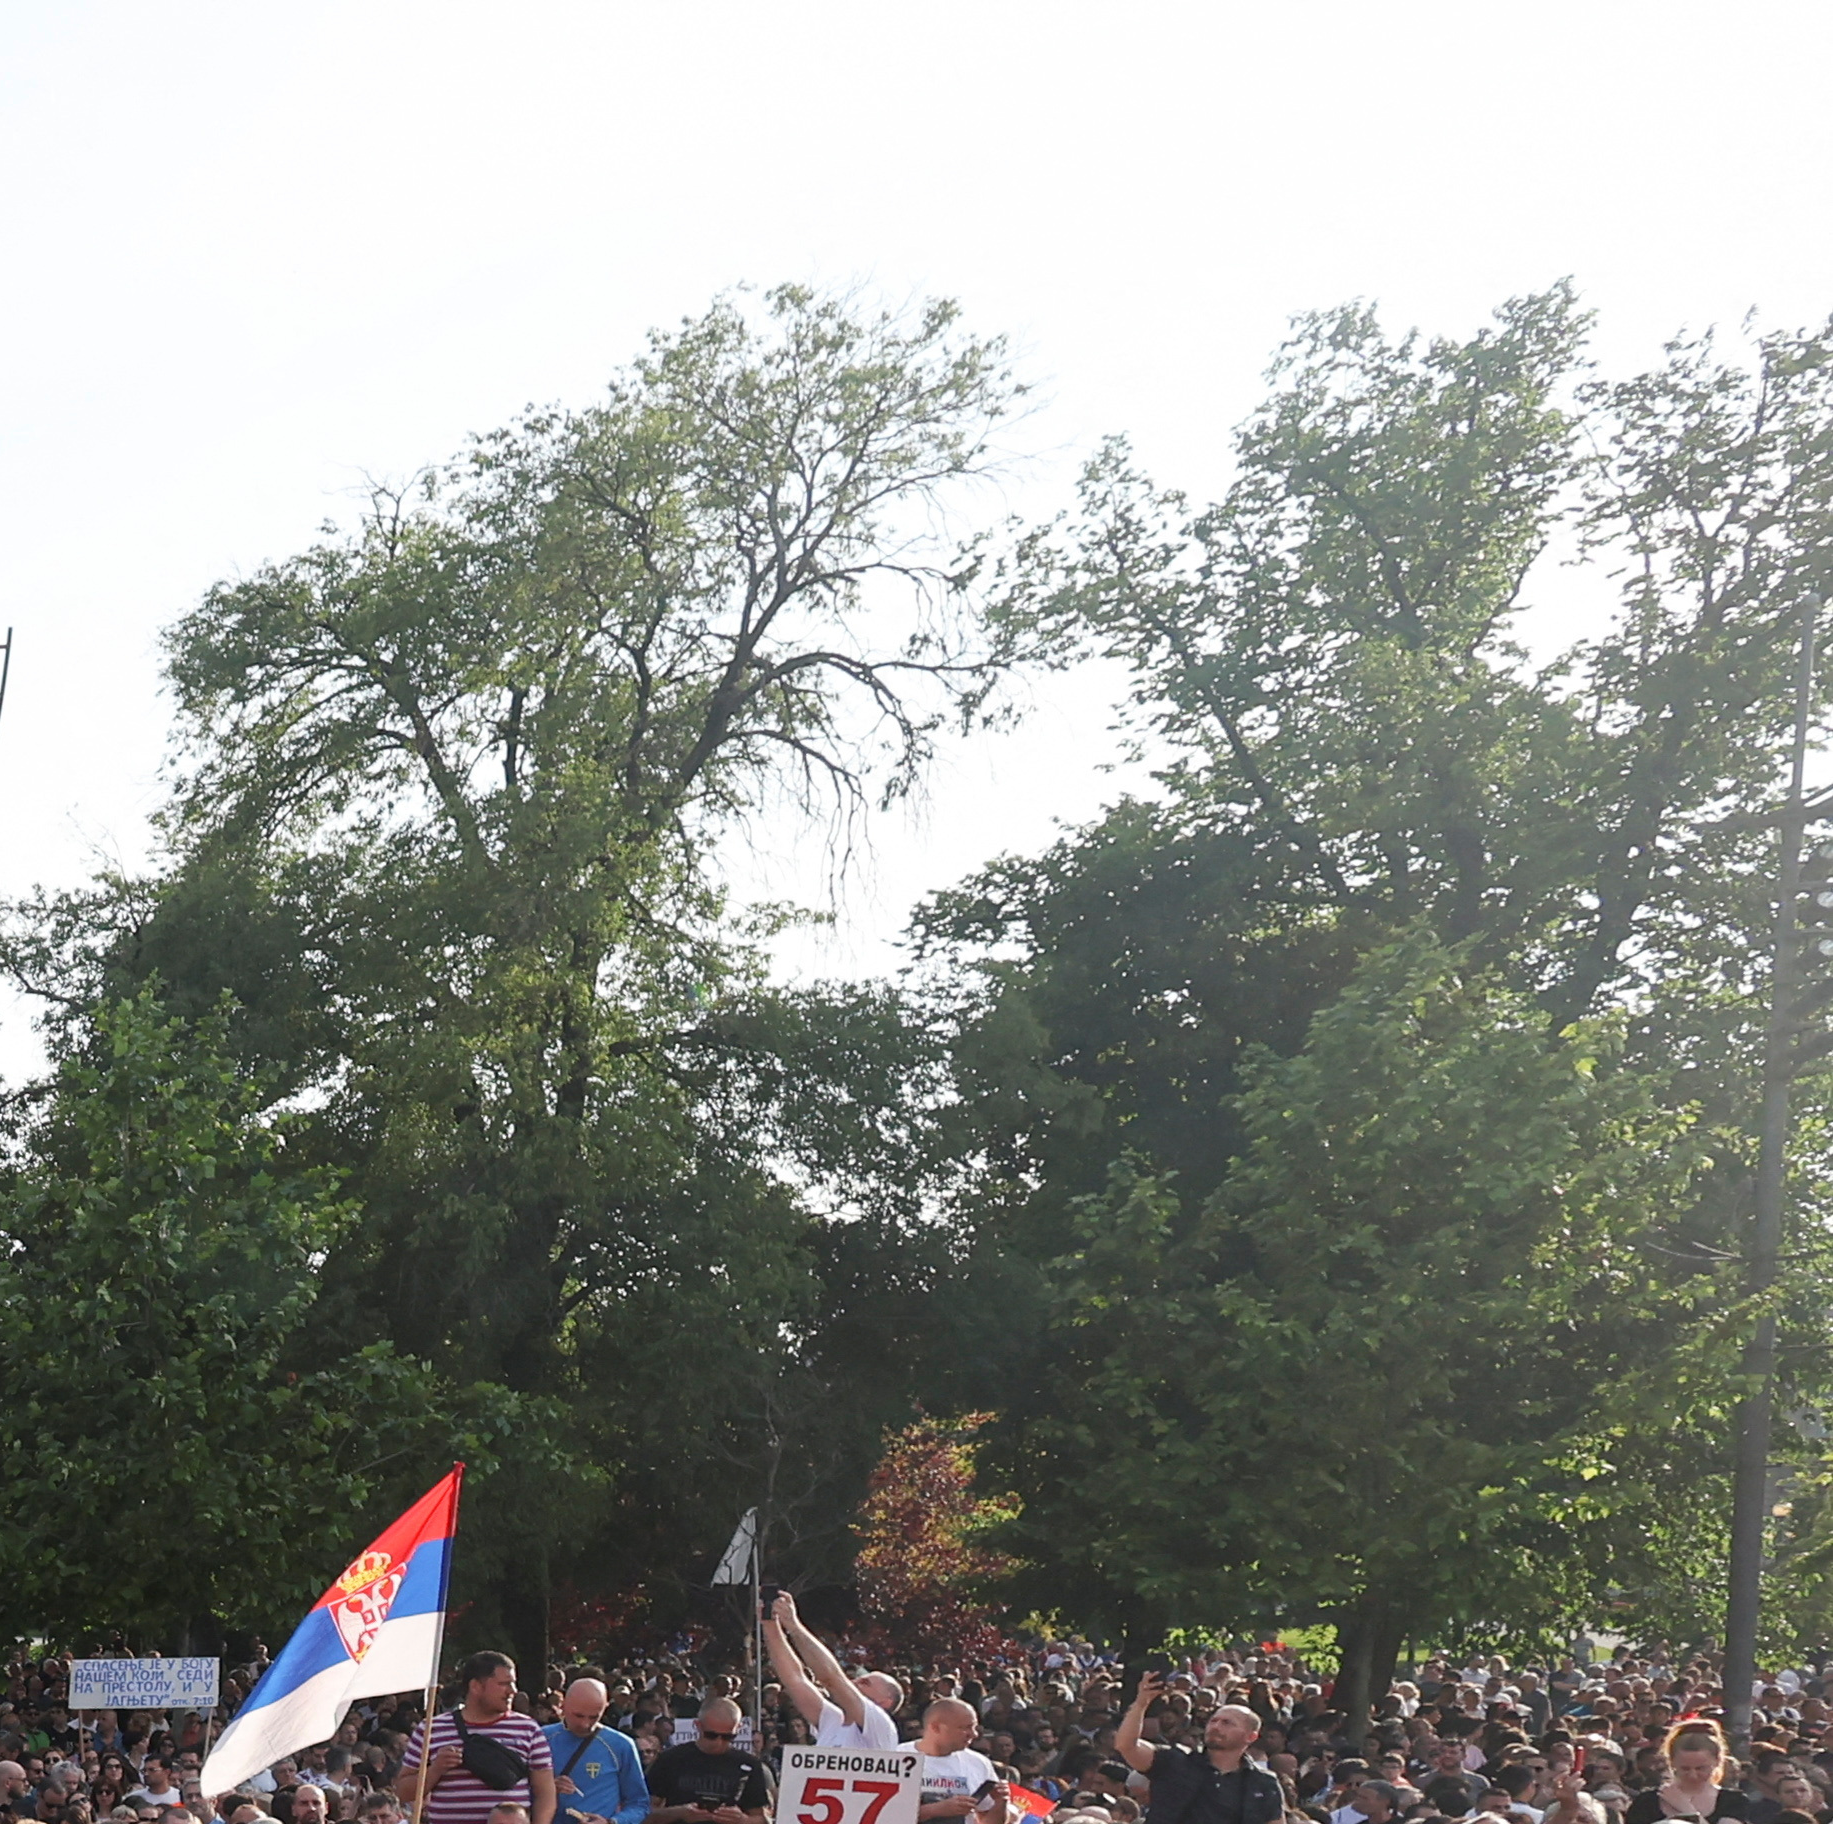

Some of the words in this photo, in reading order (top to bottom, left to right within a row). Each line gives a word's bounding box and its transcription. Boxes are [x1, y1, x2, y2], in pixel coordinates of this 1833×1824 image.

[149, 1660, 162, 1670] ЈЕ
[167, 1660, 176, 1669] У
[181, 1658, 214, 1669] БОГУ
[74, 1670, 127, 1683] НАШЕМ
[132, 1670, 164, 1681] КОЈИ
[176, 1669, 214, 1682] СЕДИ
[74, 1683, 93, 1693] НА
[182, 1682, 192, 1692] И
[204, 1681, 213, 1692] У
[791, 1752, 917, 1778] ОБРЕНОВАЦ?
